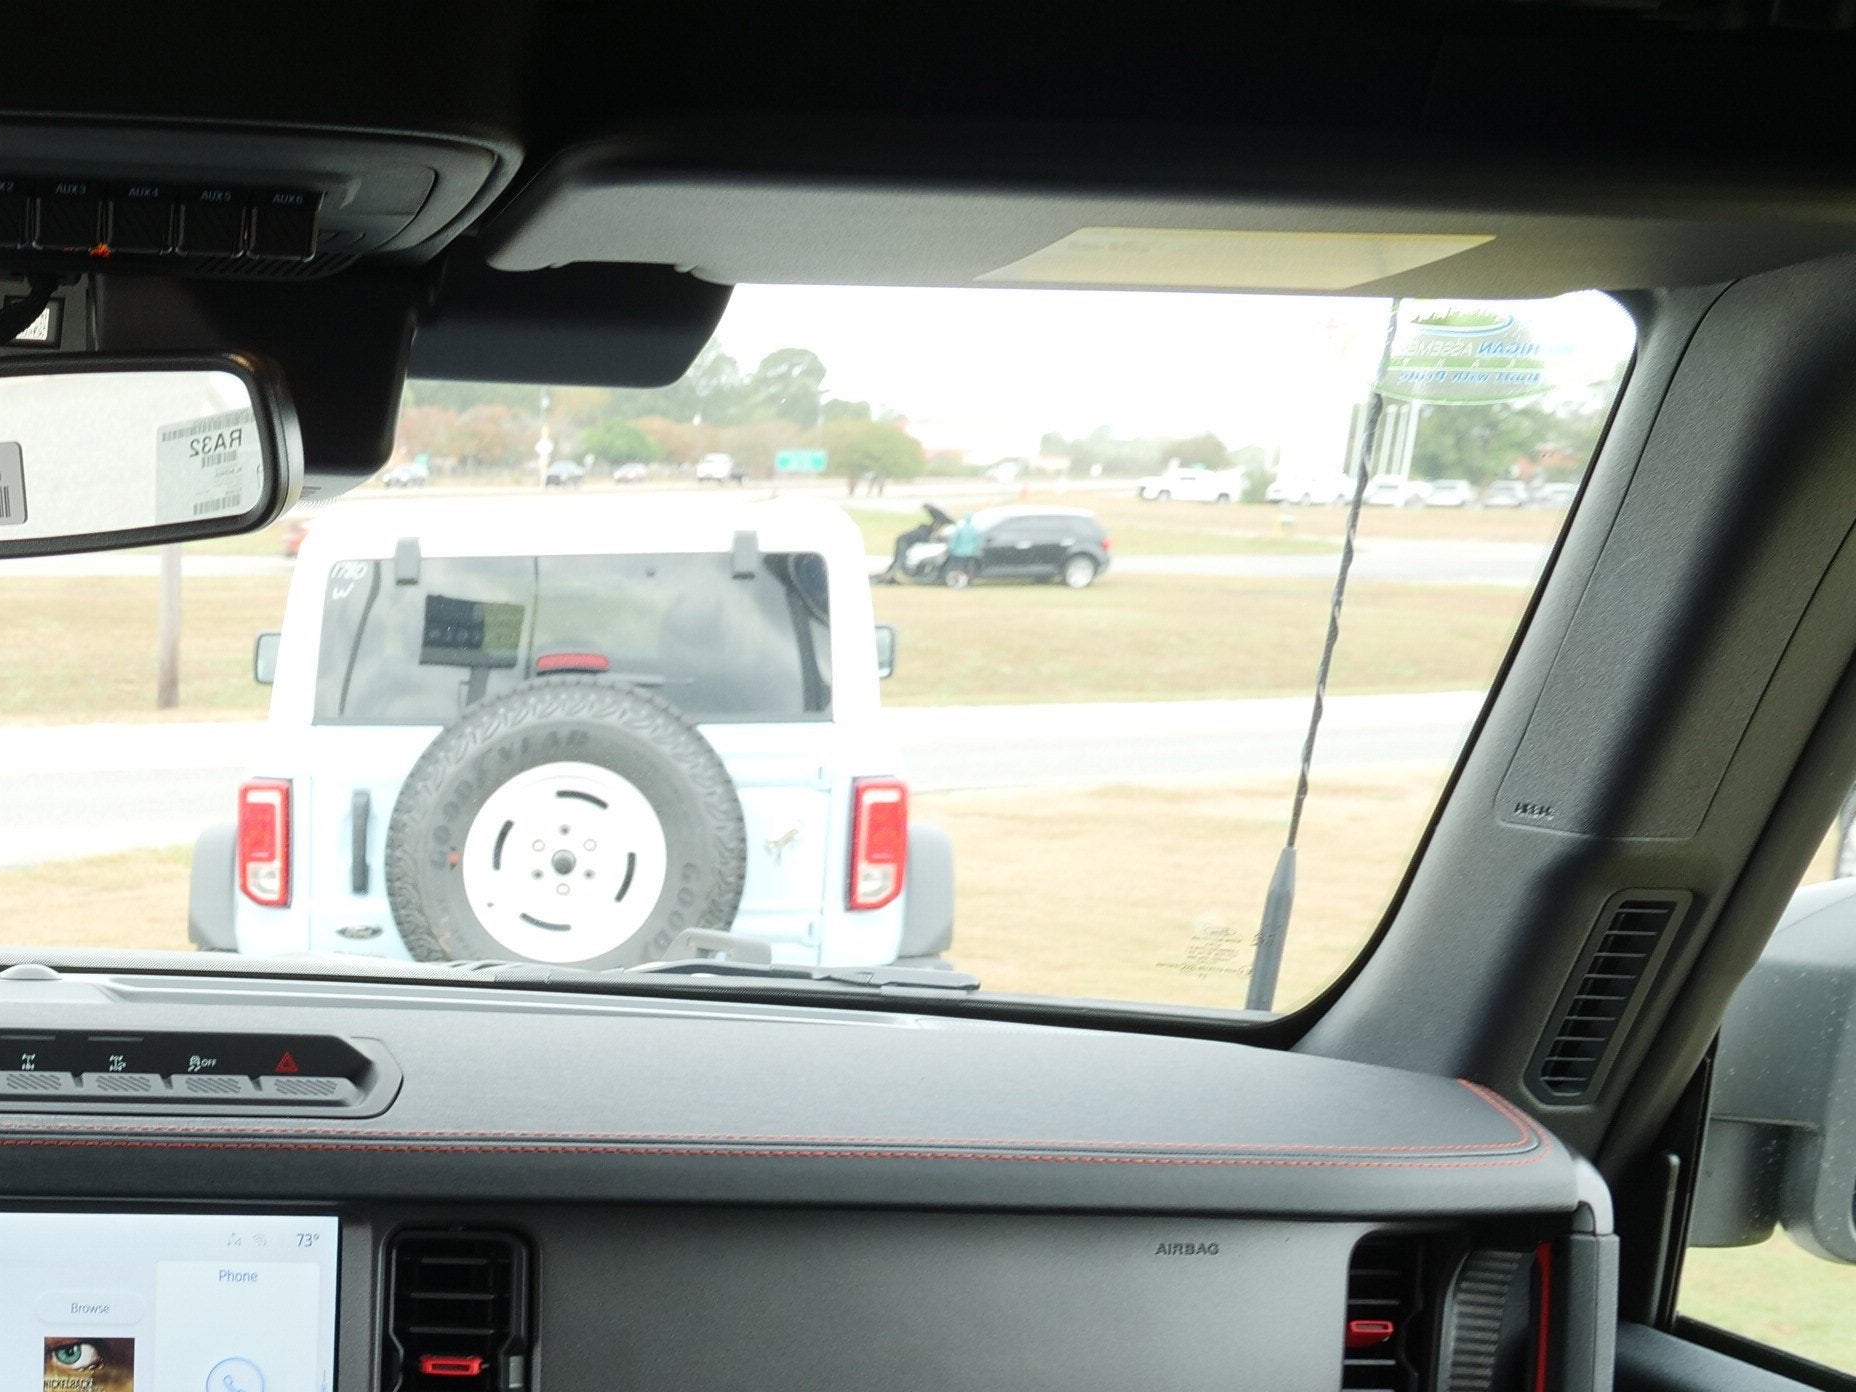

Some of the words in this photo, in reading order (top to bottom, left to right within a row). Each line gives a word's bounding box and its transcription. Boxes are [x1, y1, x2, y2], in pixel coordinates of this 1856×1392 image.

[295, 1232, 321, 1248] 73°
[1154, 1240, 1220, 1257] AIRBAG
[217, 1268, 259, 1283] Phone
[70, 1302, 111, 1315] Browse
